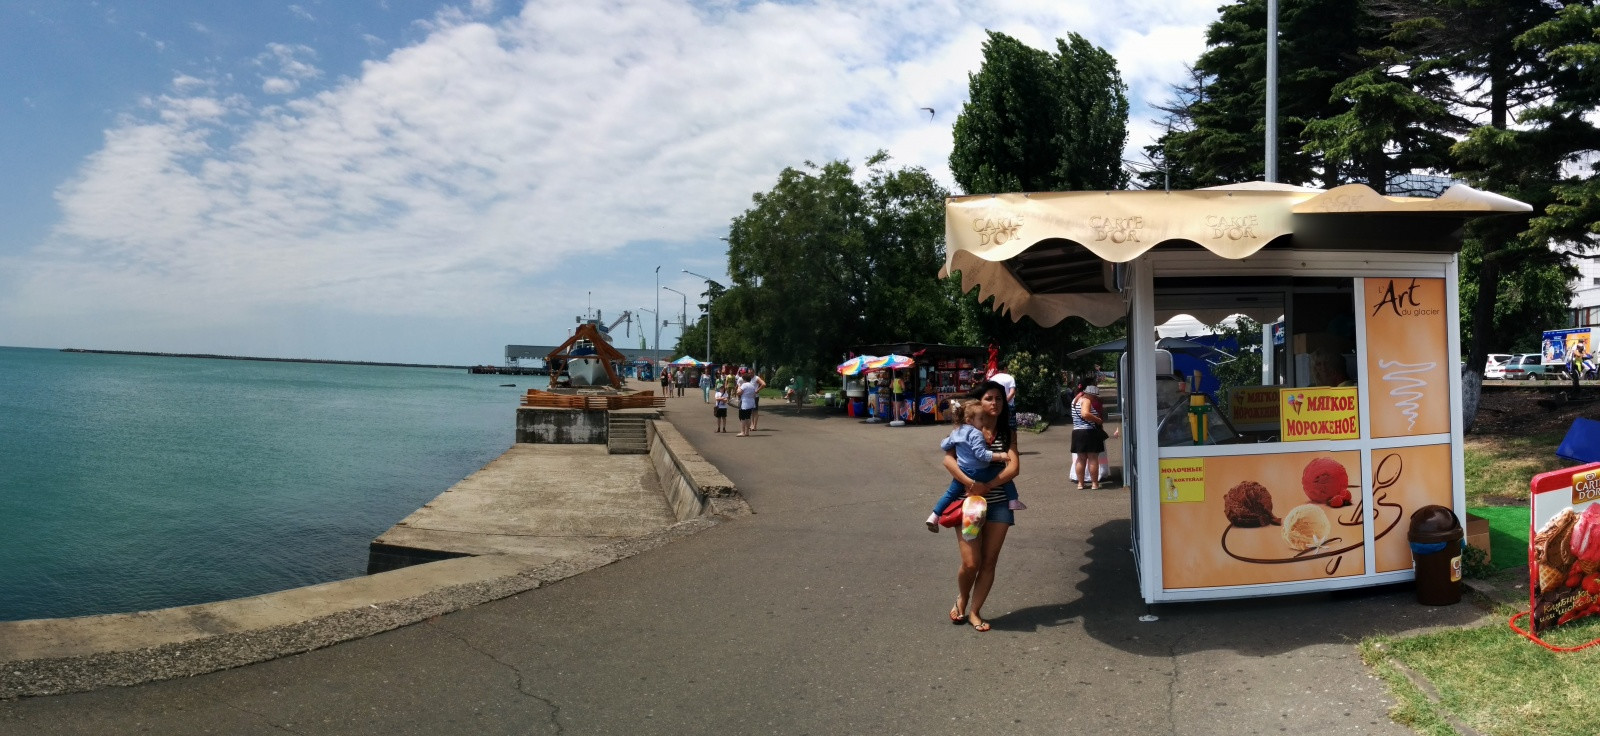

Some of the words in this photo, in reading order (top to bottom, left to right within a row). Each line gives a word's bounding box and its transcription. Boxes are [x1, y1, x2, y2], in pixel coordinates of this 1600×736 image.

[972, 213, 1025, 233] CARTE
[1089, 215, 1144, 231] CARTE
[1205, 214, 1259, 229] CARTE
[979, 227, 1021, 247] D'OR
[1095, 227, 1141, 243] D'OR
[1211, 226, 1258, 241] D'OR
[1401, 308, 1412, 316] du
[1413, 308, 1440, 317] glacier
[1306, 395, 1355, 412] МЯГКОЕ
[1161, 466, 1203, 474] МОЛОЧНЫЕ
[1575, 477, 1600, 492] CART
